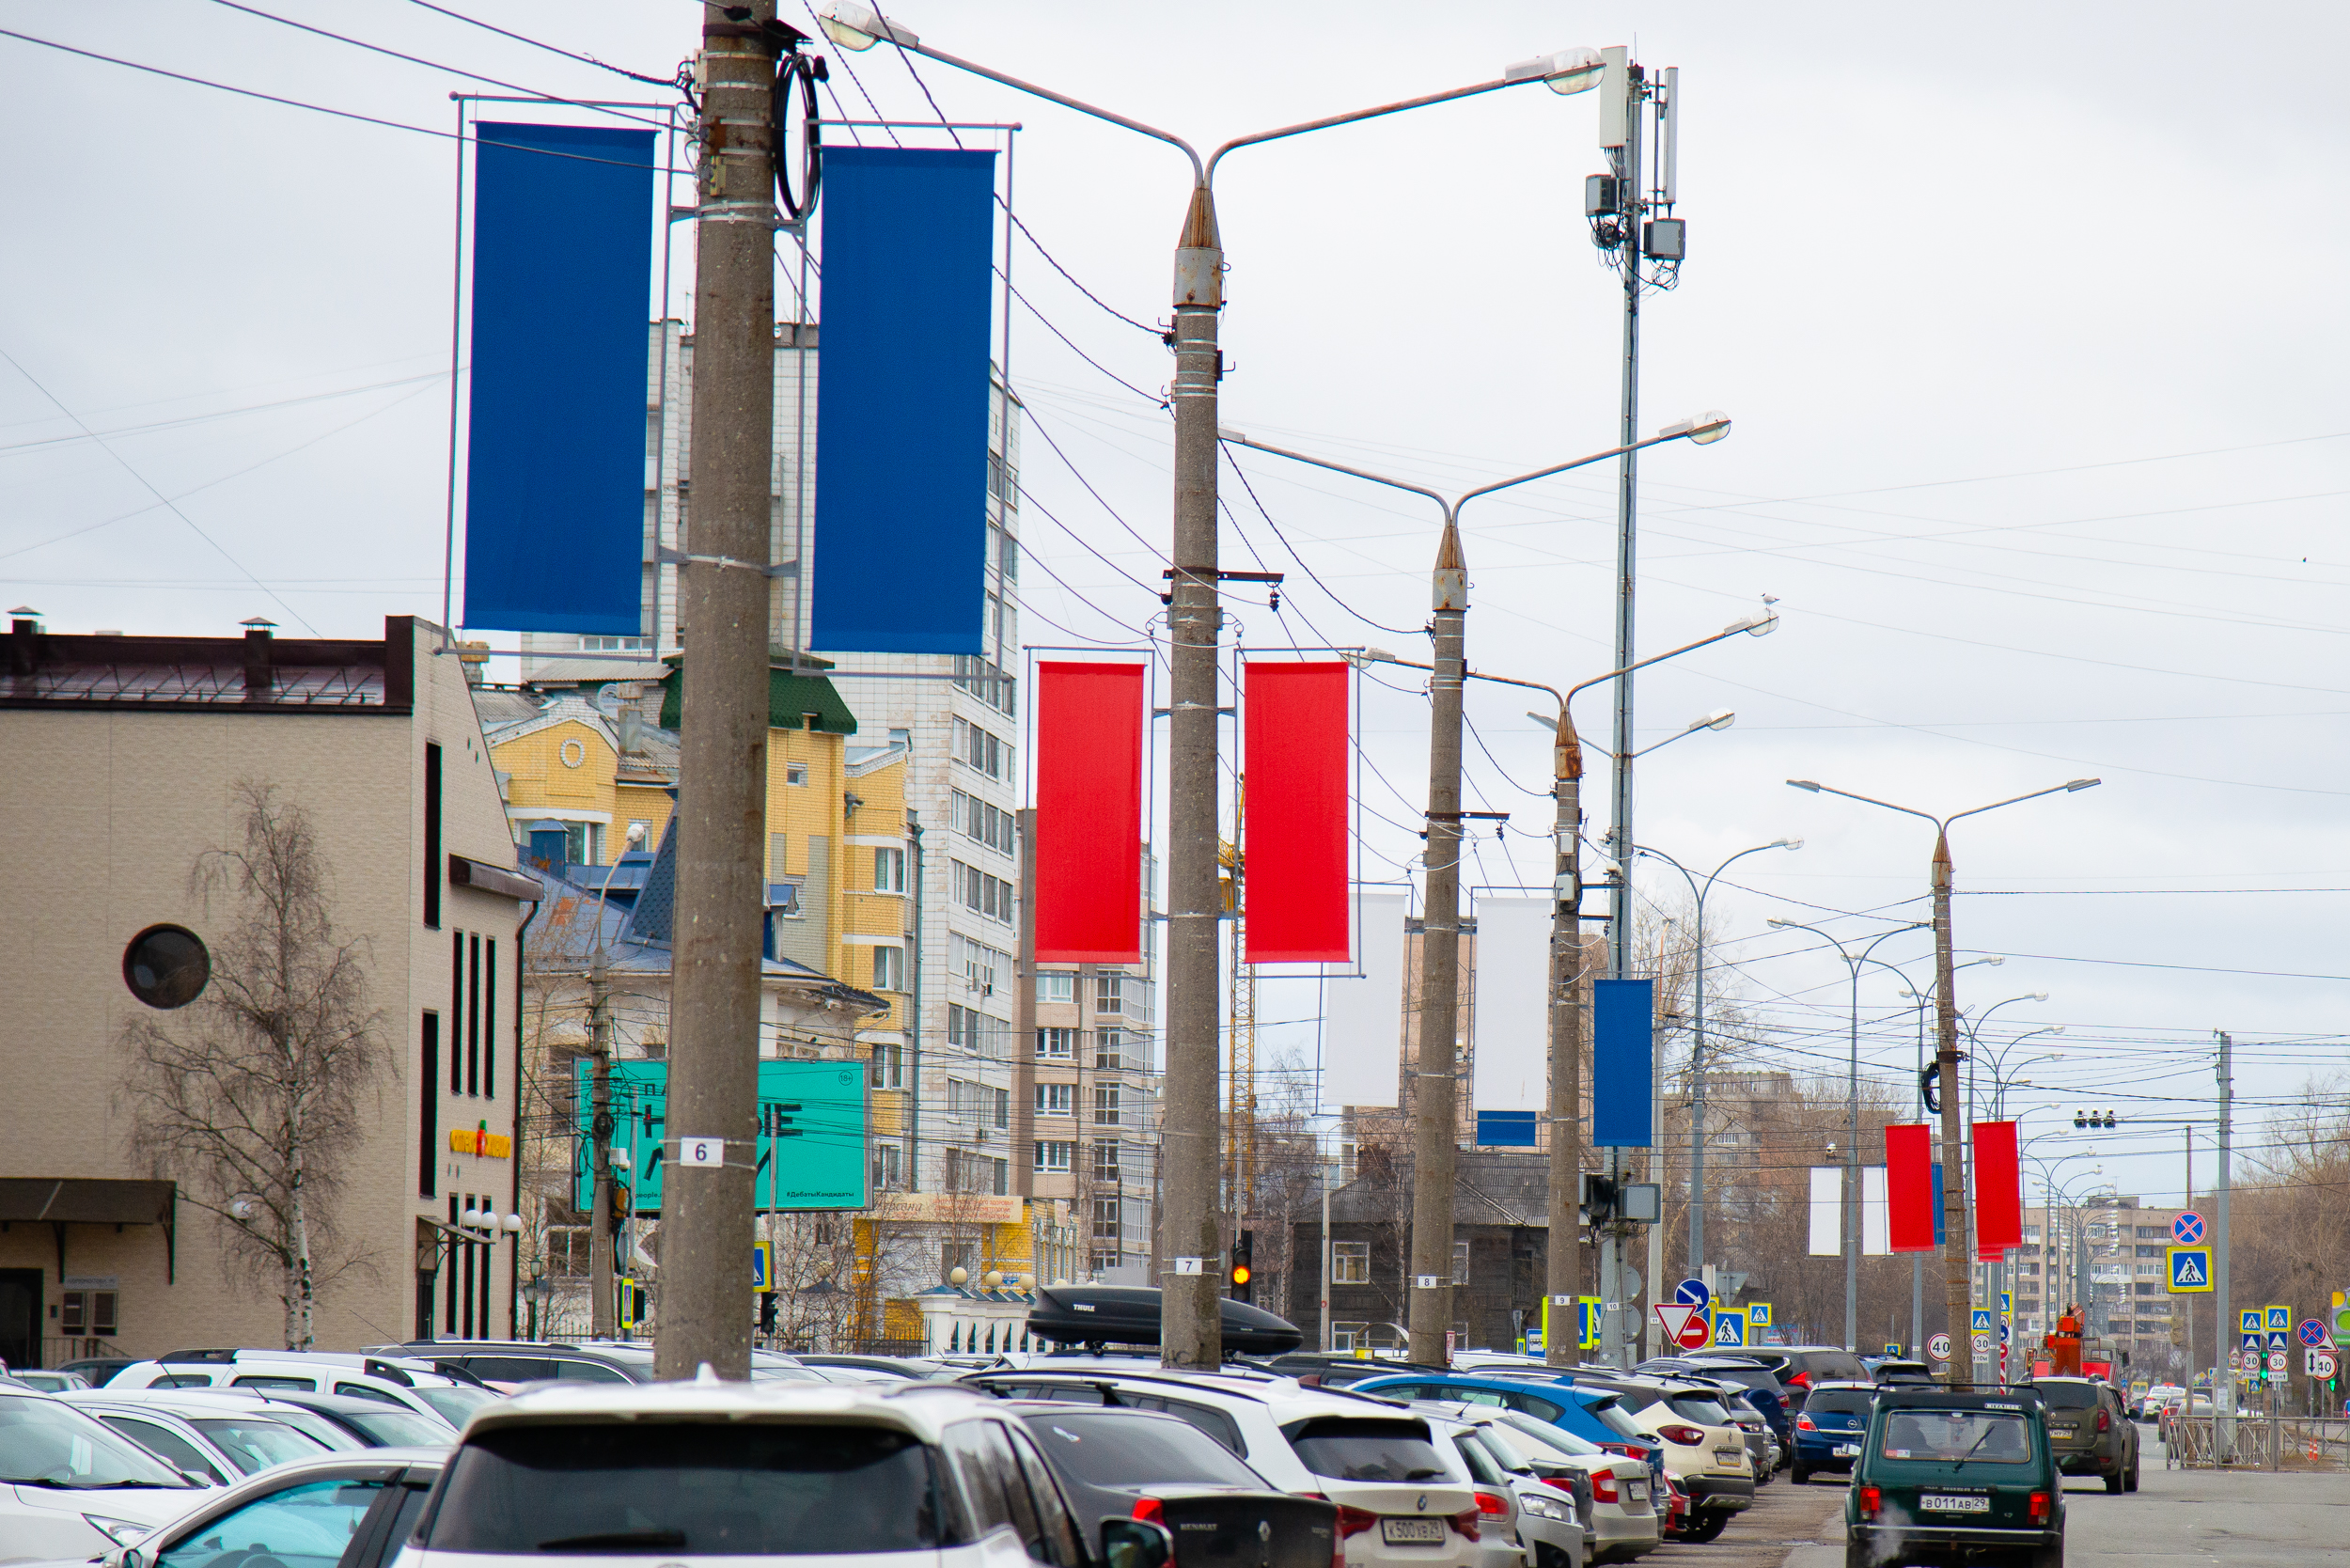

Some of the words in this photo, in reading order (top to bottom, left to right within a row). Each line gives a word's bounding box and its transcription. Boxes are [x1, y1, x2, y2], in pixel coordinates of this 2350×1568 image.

[695, 1143, 707, 1161] 6
[1185, 1261, 1193, 1273] 7
[1424, 1278, 1430, 1287] 8
[1073, 1304, 1095, 1312] THULE
[1933, 1341, 1950, 1353] 40
[1976, 1340, 1988, 1348] 30
[2318, 1361, 2331, 1372] 40
[1974, 1498, 1986, 1507] 29
